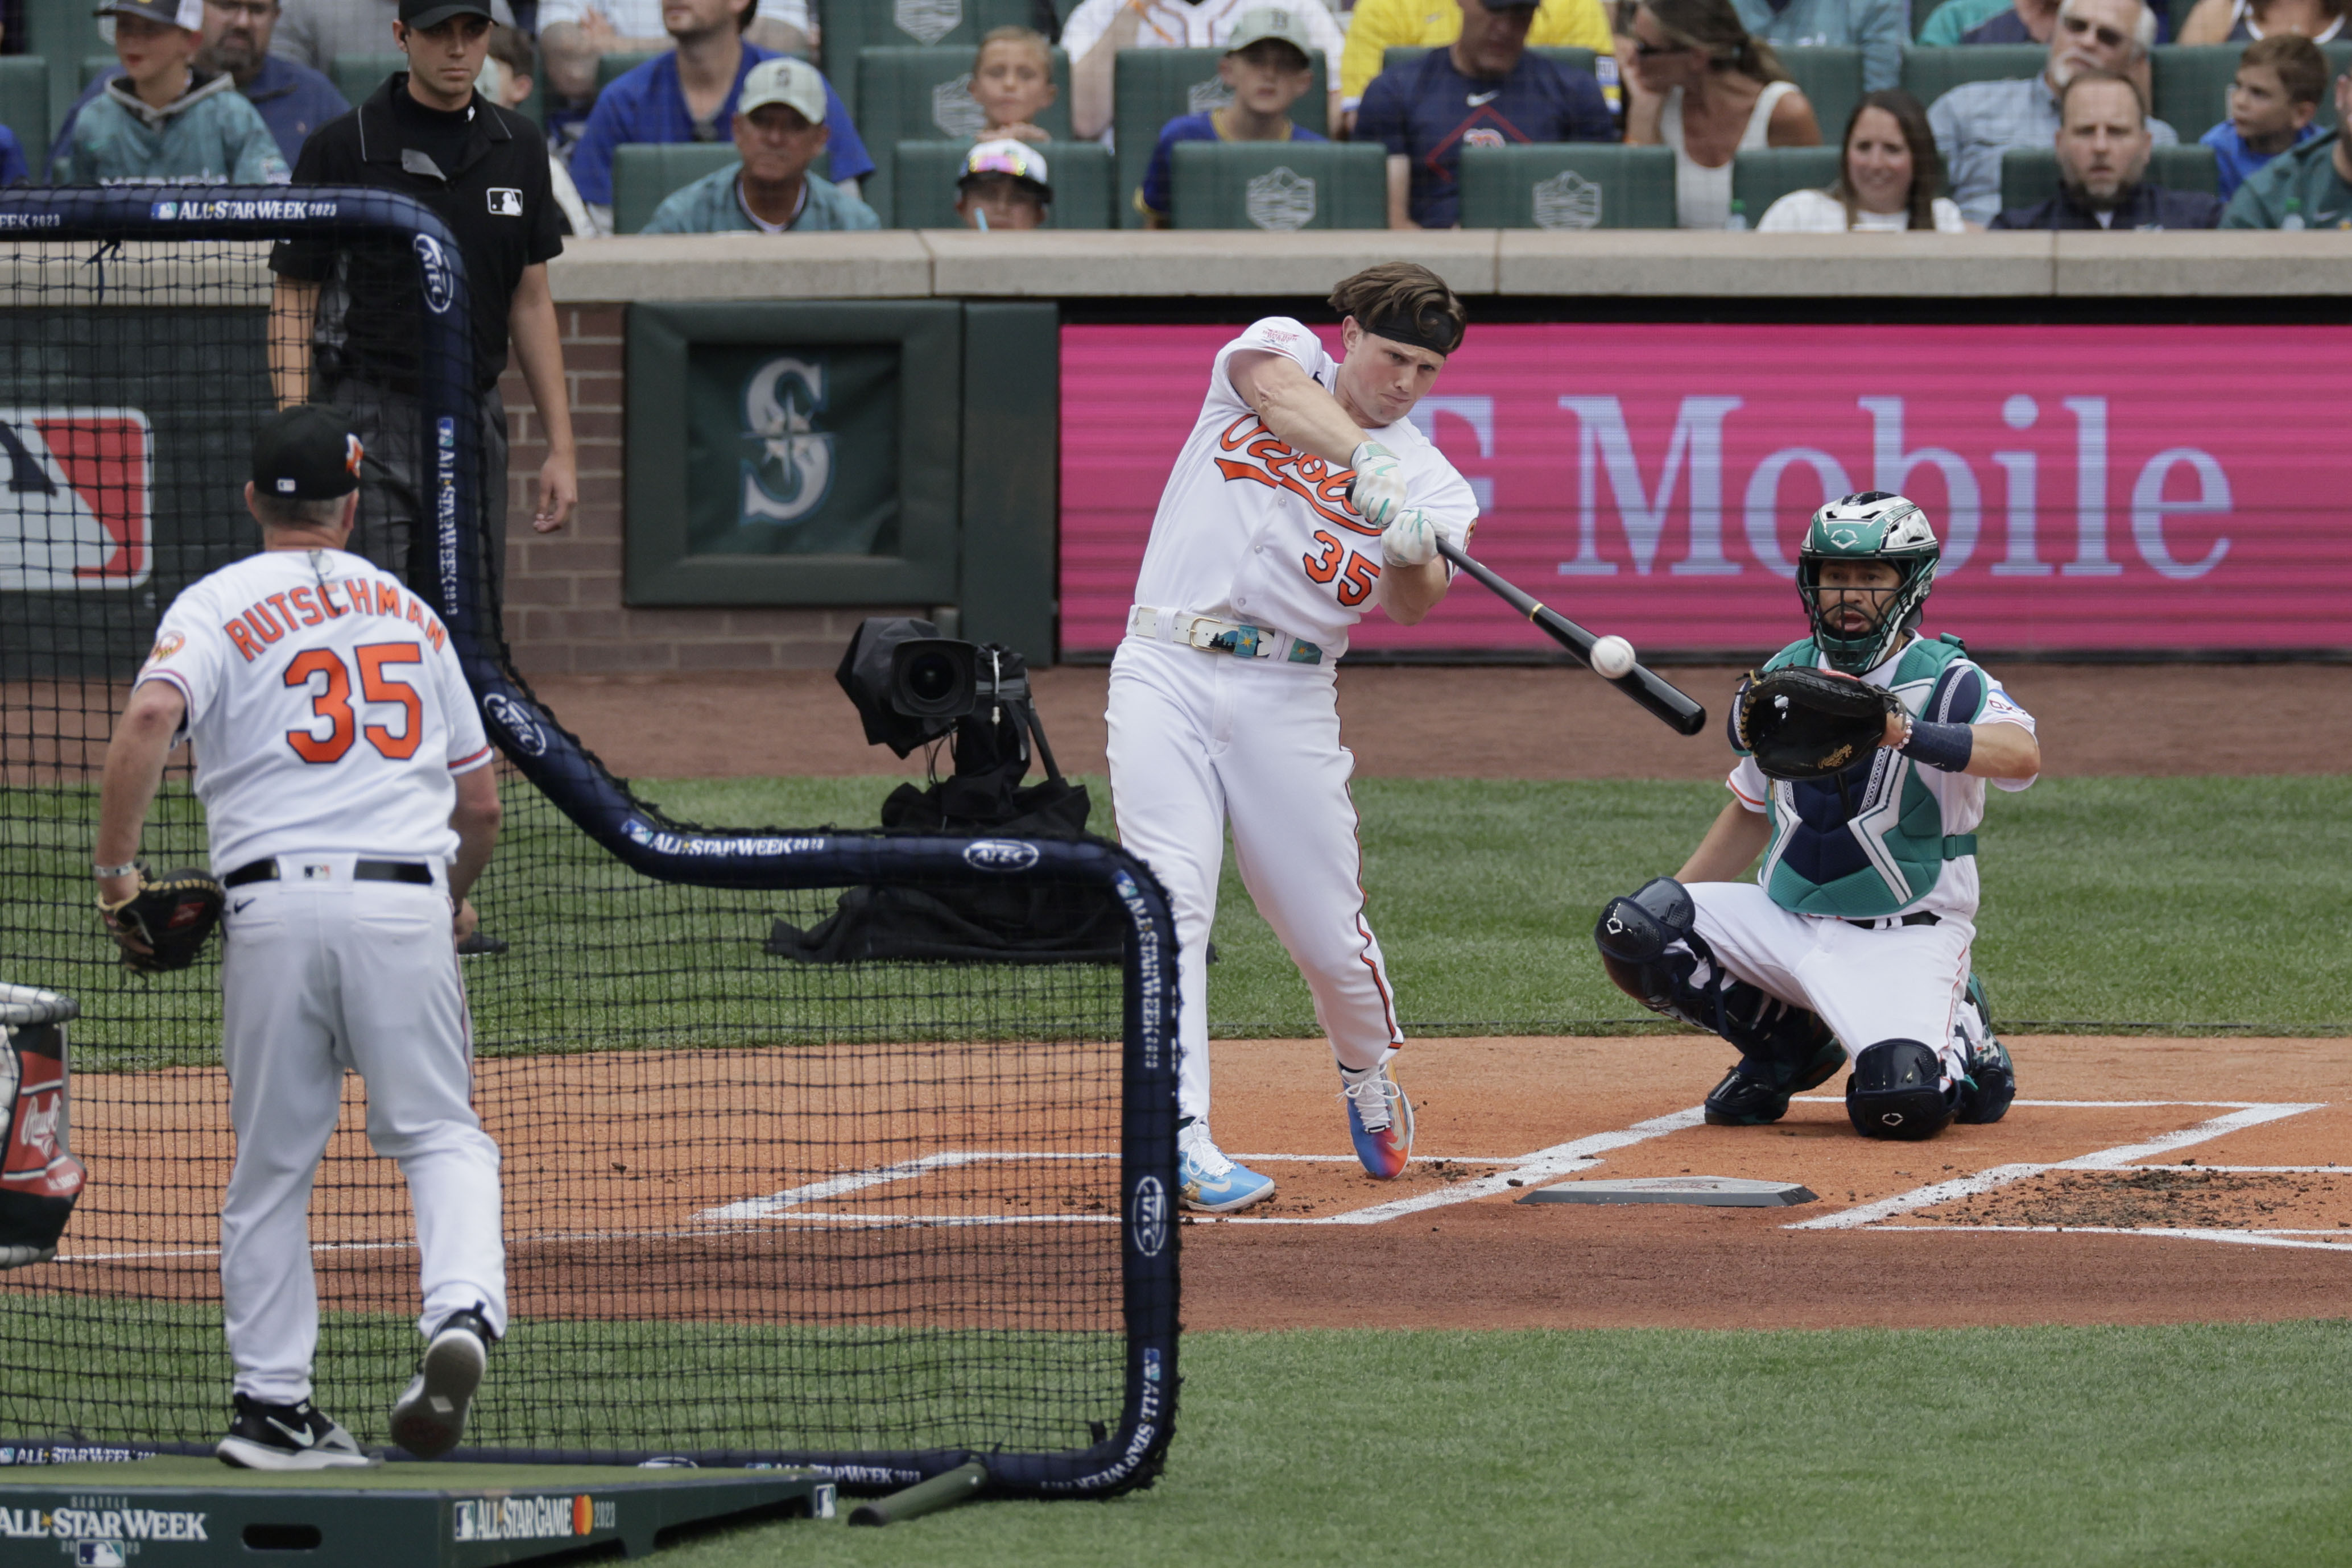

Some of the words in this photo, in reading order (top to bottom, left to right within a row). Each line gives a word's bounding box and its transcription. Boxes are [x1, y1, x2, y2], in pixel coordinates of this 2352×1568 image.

[308, 202, 337, 217] 2023
[1557, 394, 2234, 580] Mobile
[1303, 529, 1381, 607] 35
[224, 578, 447, 663] RUTSCHMAN
[282, 640, 423, 764] 35
[793, 839, 824, 851] 2023
[69, 1495, 129, 1508] SEATTLE
[476, 1499, 502, 1540] ALL
[502, 1496, 535, 1540] STAR
[534, 1495, 573, 1538] GAME
[594, 1501, 615, 1528] 2023
[52, 1508, 123, 1538] STAR
[120, 1509, 208, 1541] WEEK
